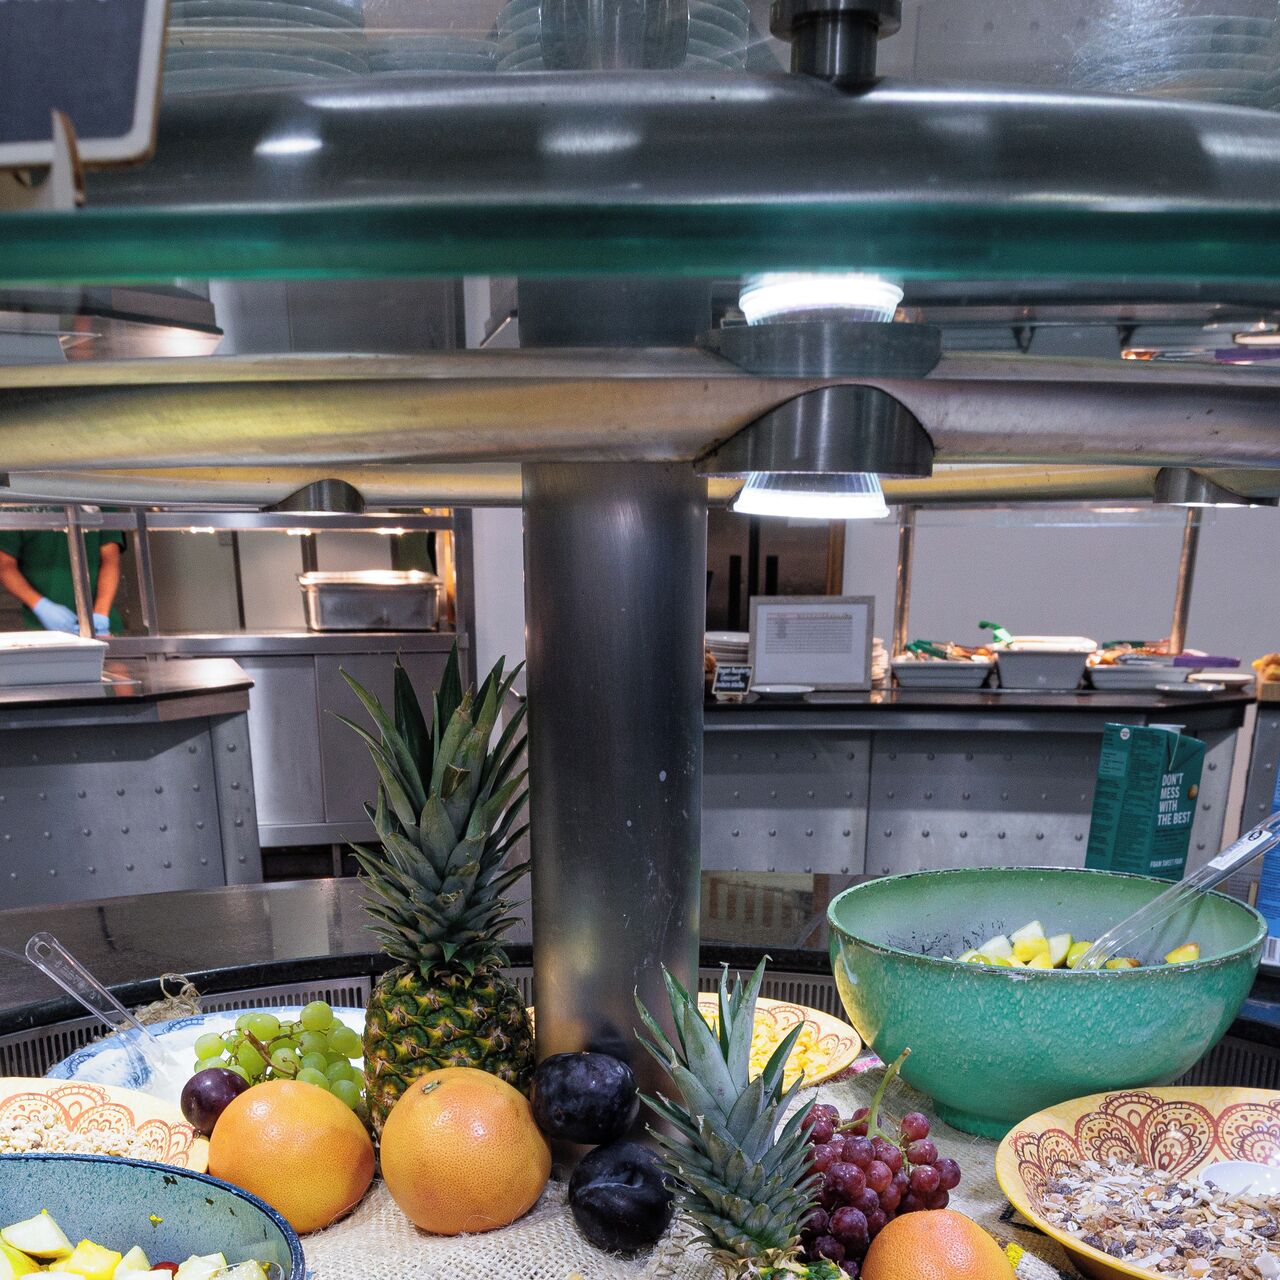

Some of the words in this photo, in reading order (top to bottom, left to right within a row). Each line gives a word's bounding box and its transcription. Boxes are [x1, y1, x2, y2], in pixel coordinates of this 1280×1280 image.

[1162, 772, 1184, 786] DON'T
[1160, 786, 1180, 799] MESS
[1158, 799, 1178, 813] WITH
[1157, 813, 1172, 826] THE
[1173, 811, 1191, 824] BEST
